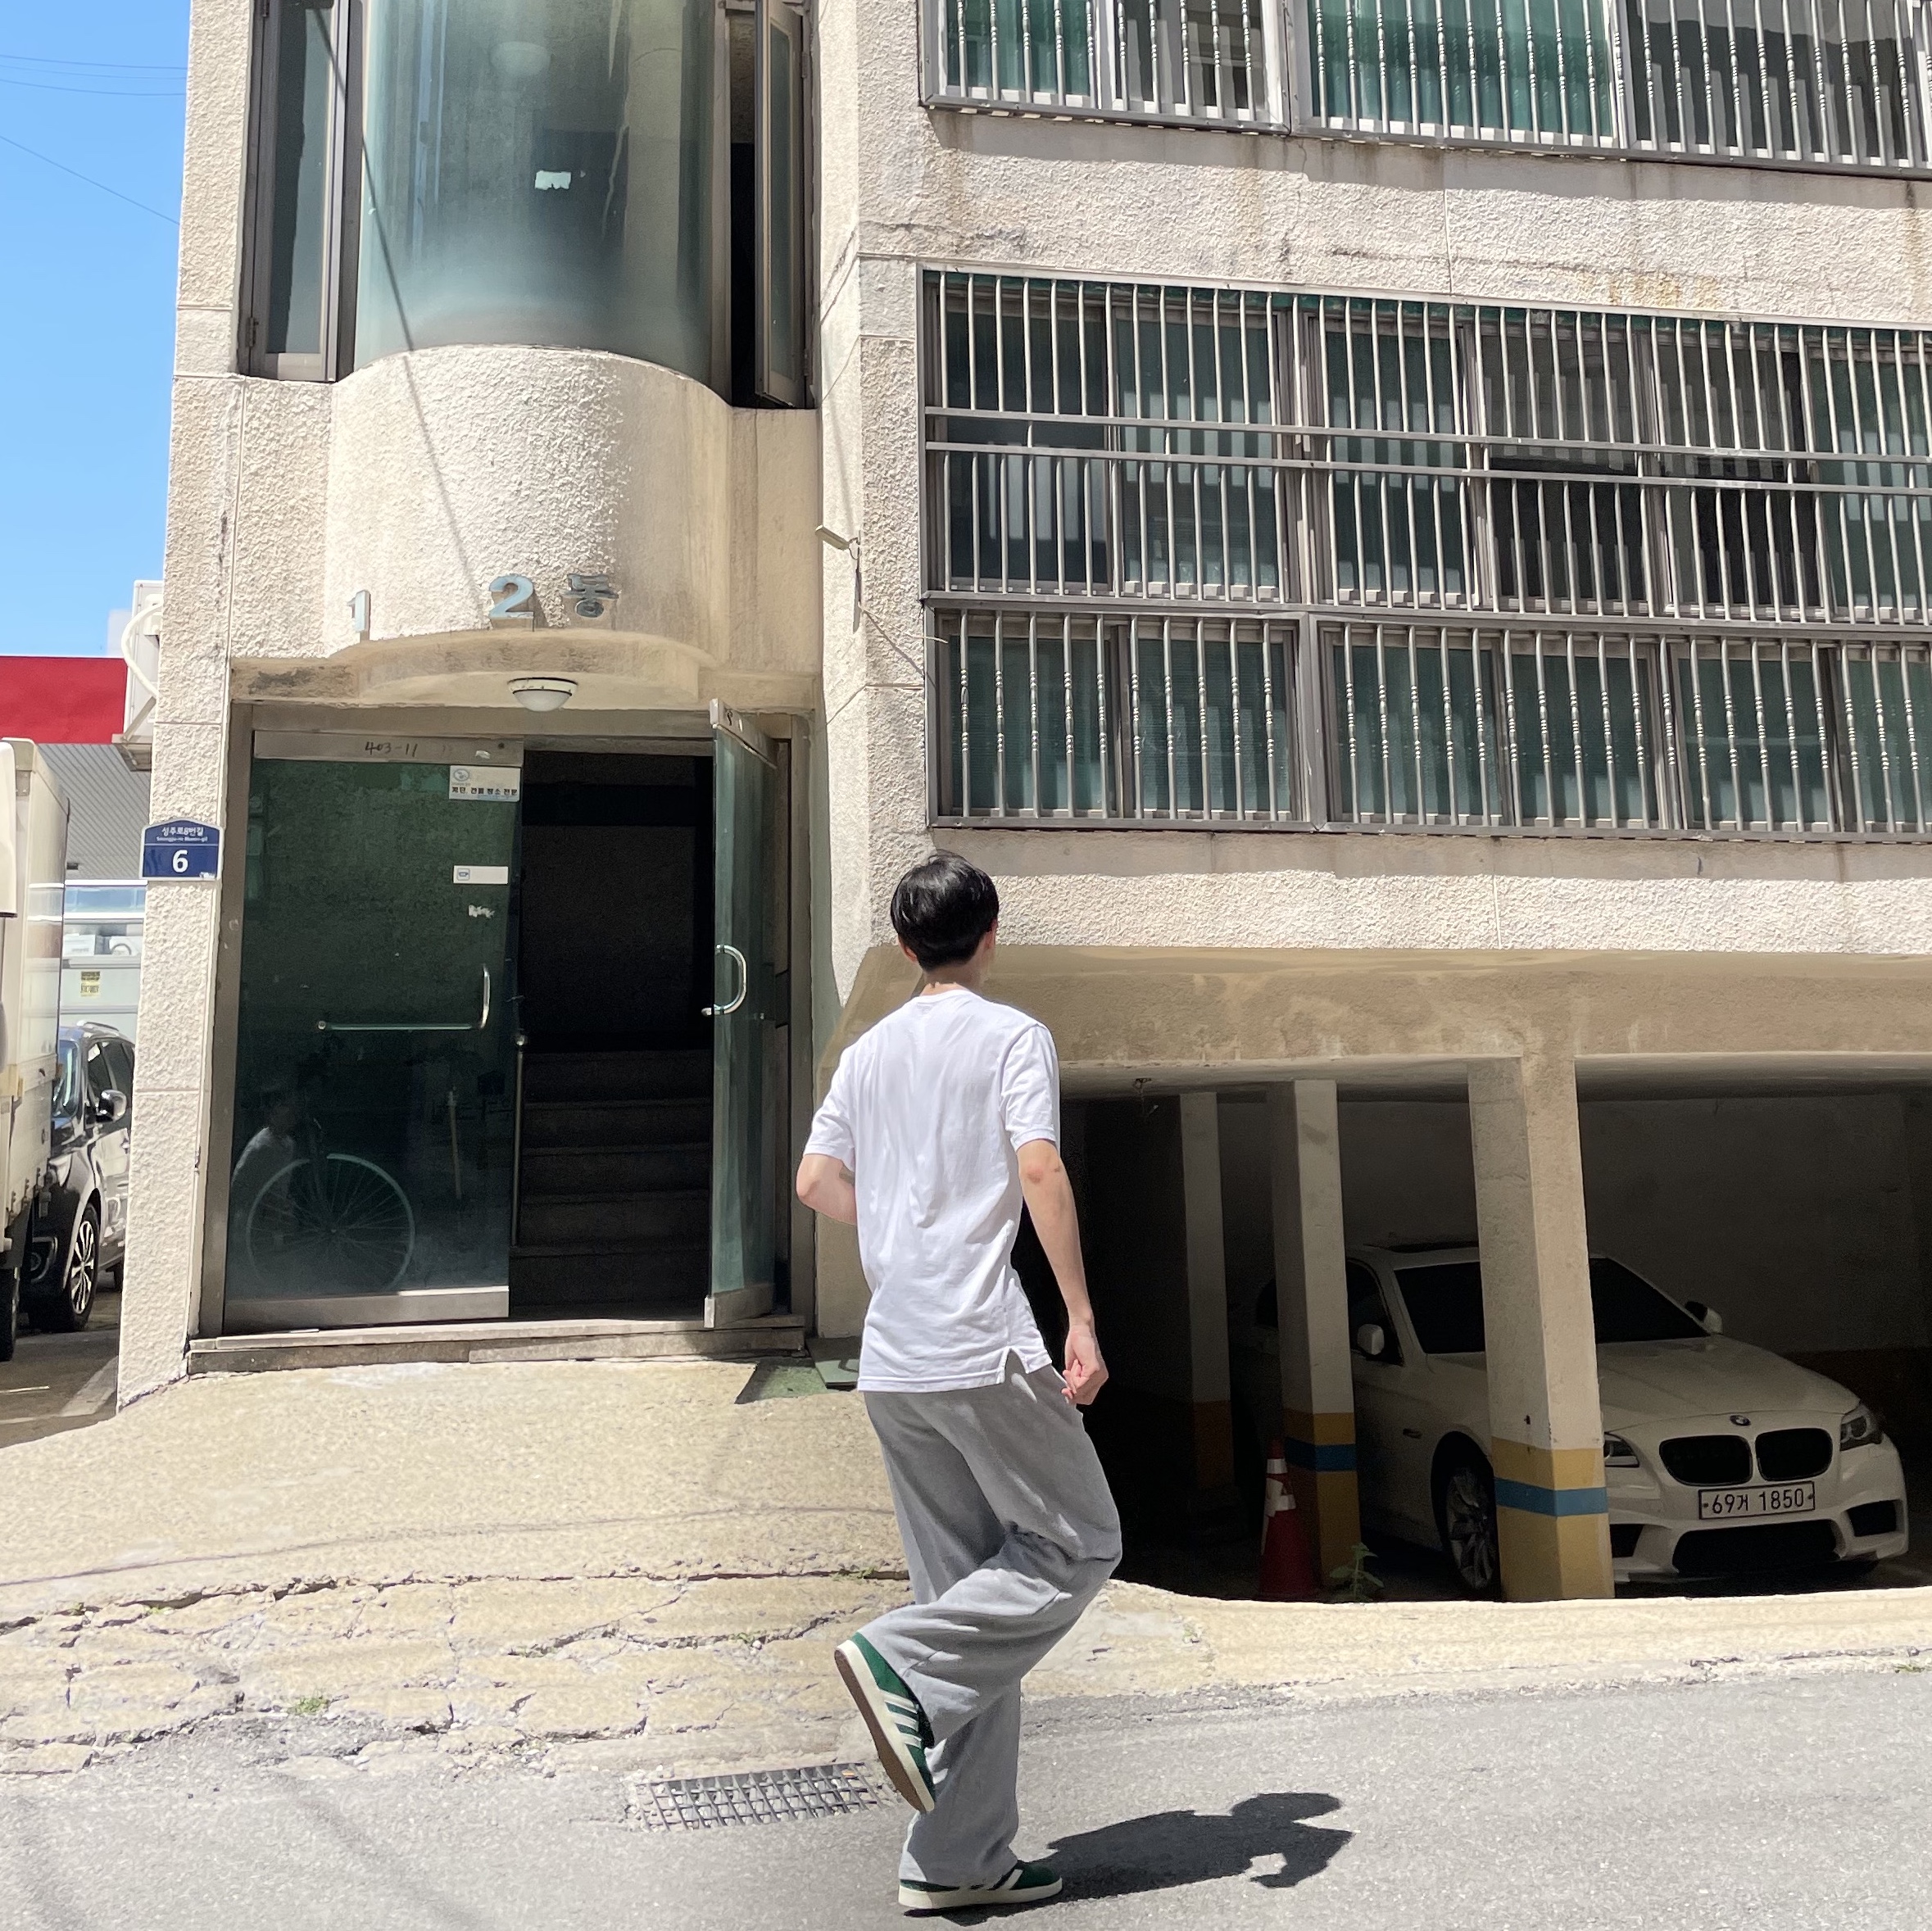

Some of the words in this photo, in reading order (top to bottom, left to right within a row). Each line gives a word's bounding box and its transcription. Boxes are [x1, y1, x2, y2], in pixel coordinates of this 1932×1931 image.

[488, 574, 535, 620] 2
[562, 573, 619, 618] 동
[365, 741, 418, 757] 403-11
[172, 850, 188, 873] 6
[1759, 1488, 1804, 1512] 1850
